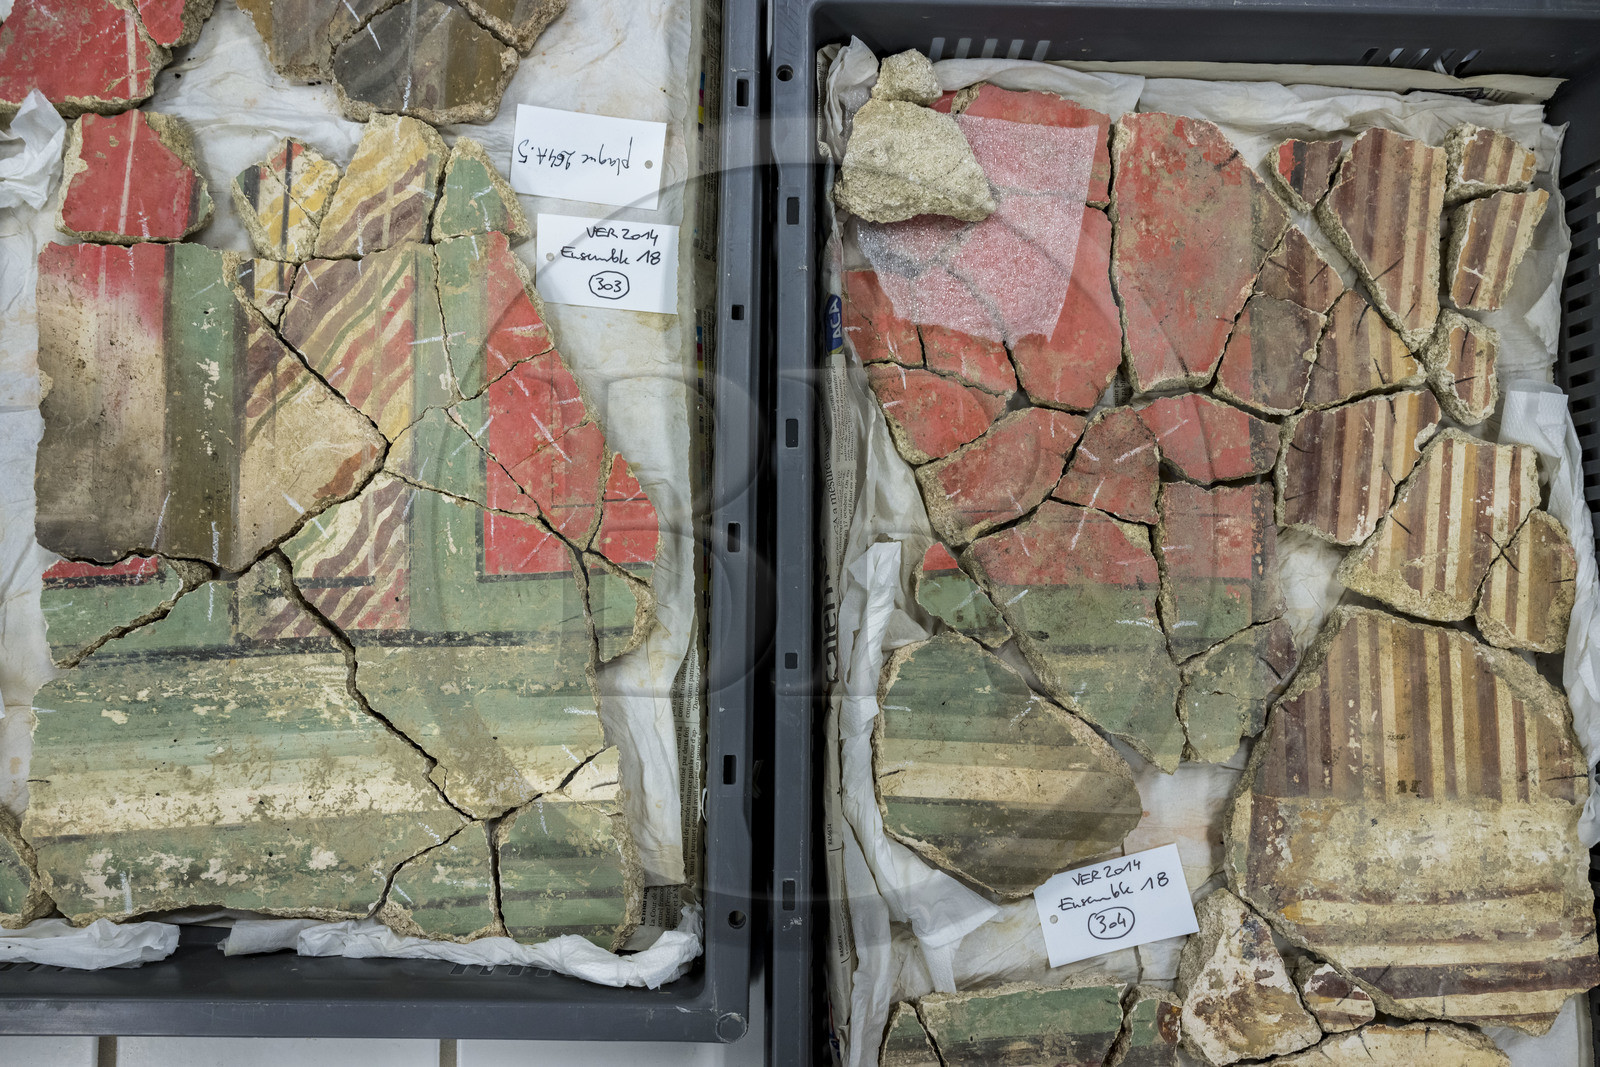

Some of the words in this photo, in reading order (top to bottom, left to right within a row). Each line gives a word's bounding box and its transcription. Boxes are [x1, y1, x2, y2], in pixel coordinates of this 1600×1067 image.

[581, 137, 633, 176] plaque
[636, 251, 661, 266] 18
[595, 277, 623, 292] 303
[828, 297, 843, 339] ACA
[685, 682, 693, 718] conséquent
[1140, 872, 1170, 891] 18
[1095, 912, 1127, 934] 304
